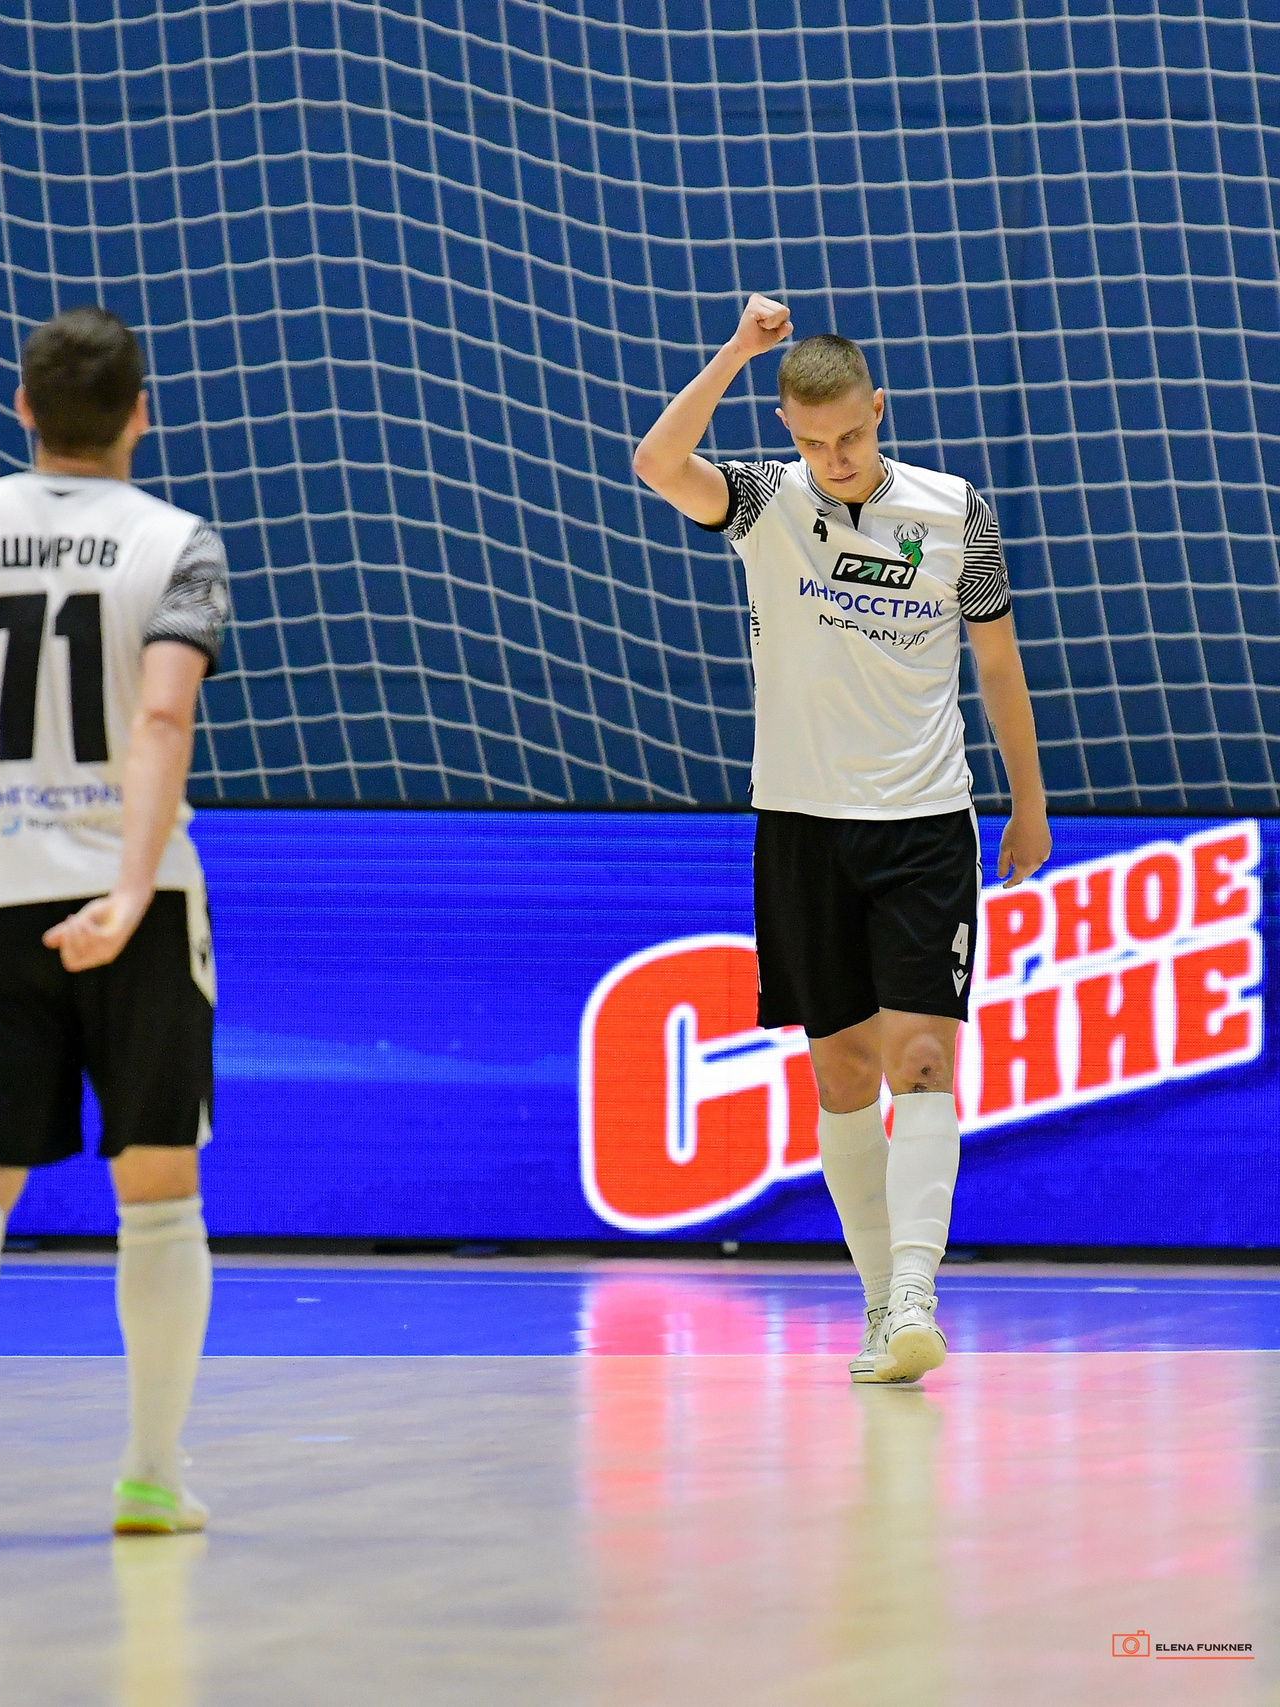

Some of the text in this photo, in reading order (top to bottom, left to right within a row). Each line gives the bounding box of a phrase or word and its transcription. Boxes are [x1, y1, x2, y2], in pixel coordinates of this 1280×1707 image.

[813, 518, 829, 543] 4
[835, 558, 915, 585] PARI
[951, 922, 969, 966] 4
